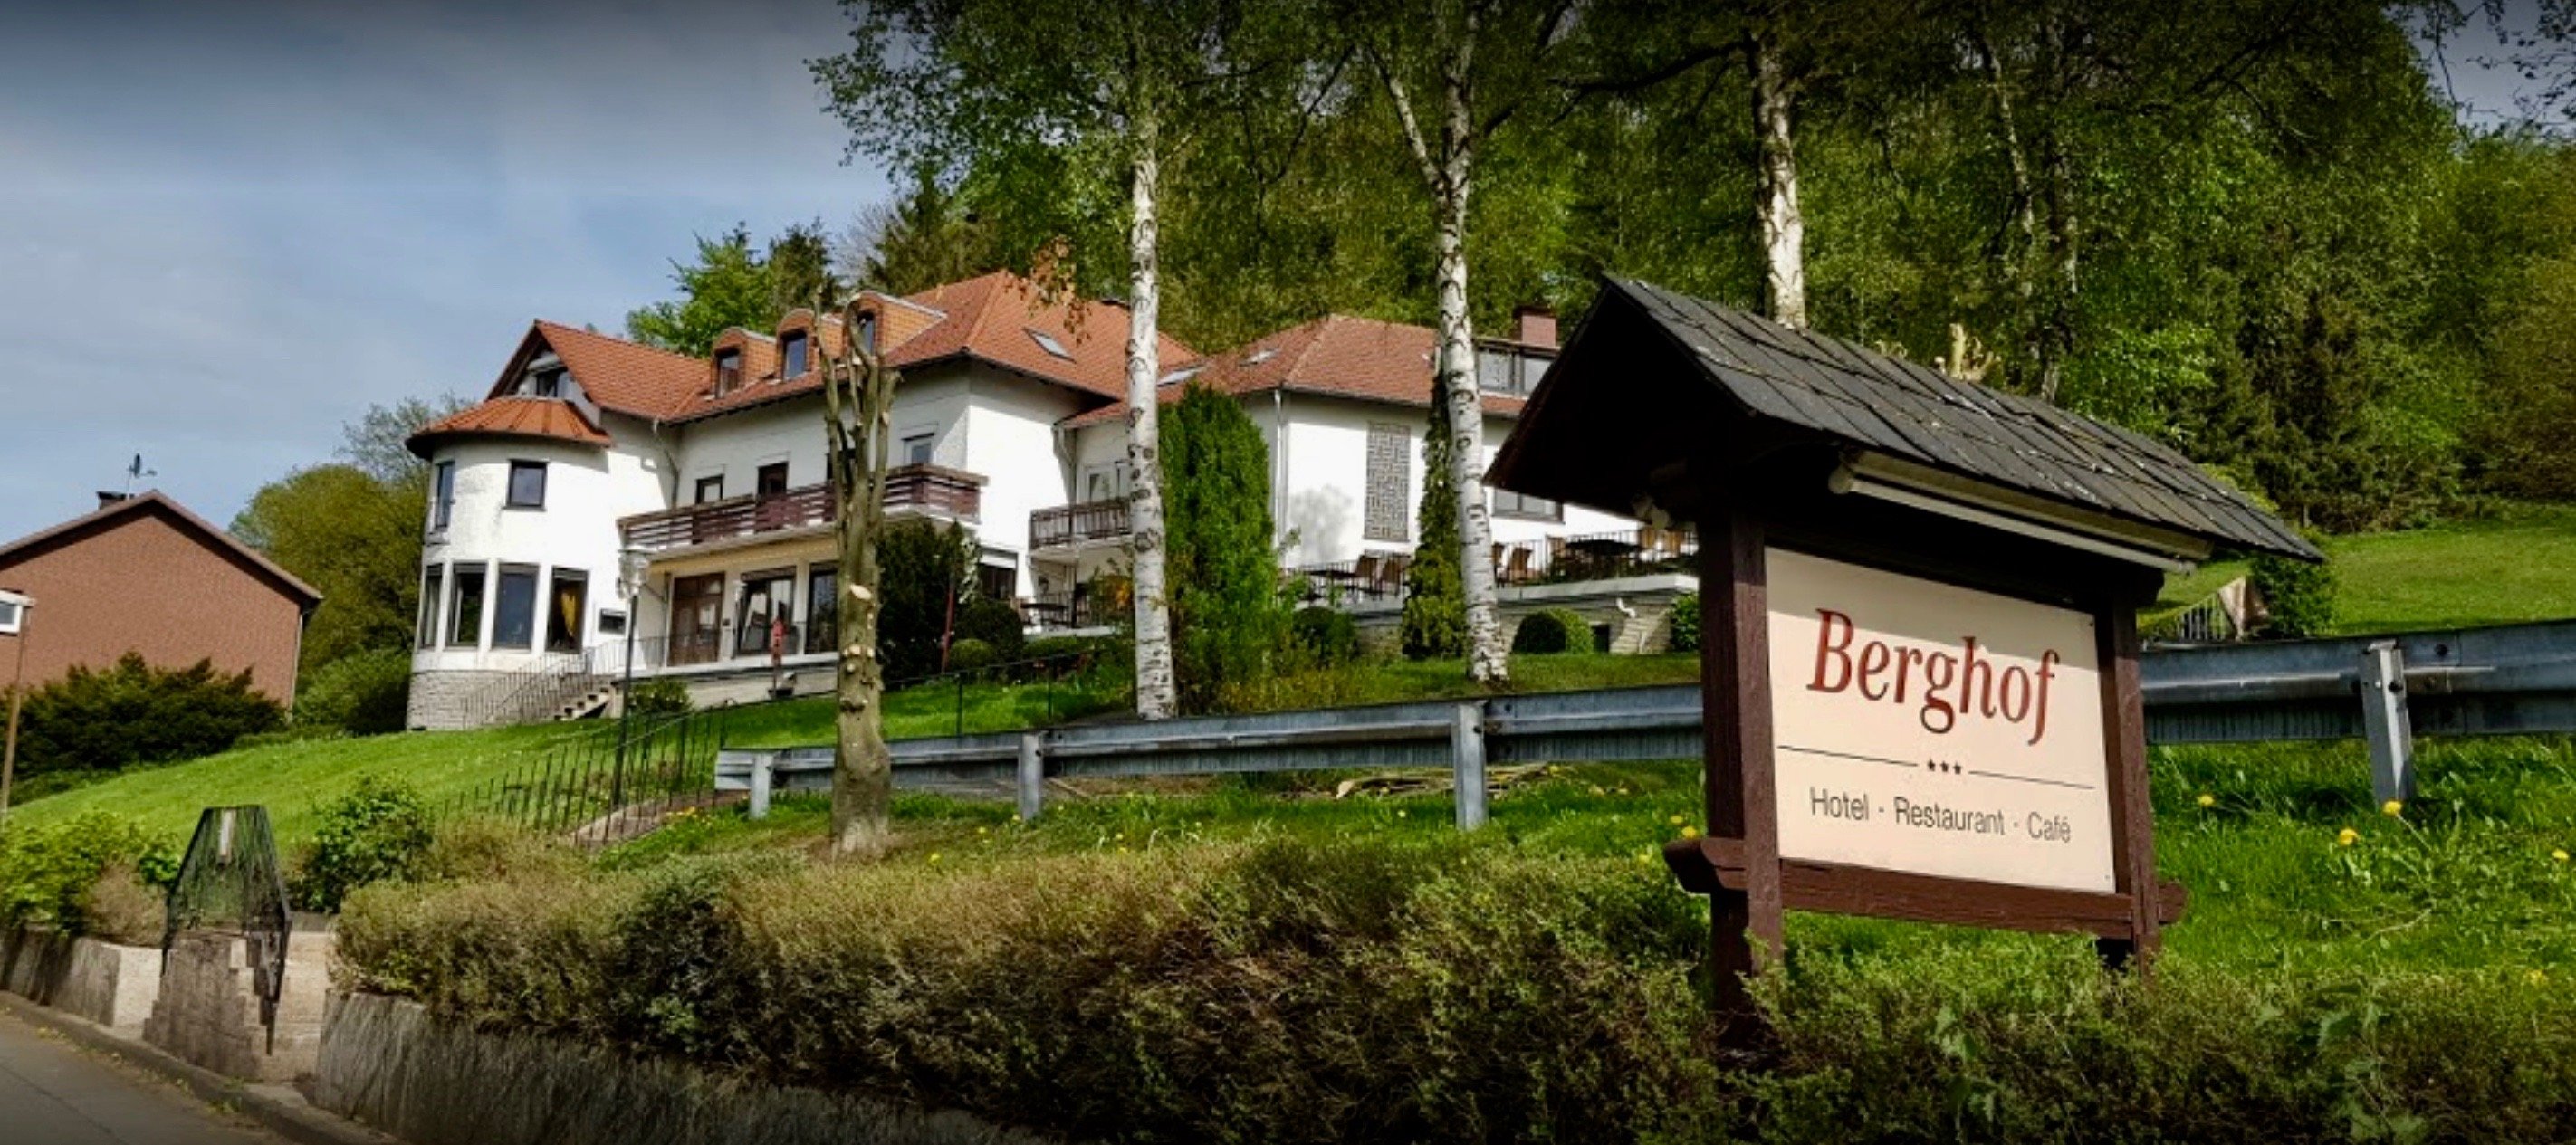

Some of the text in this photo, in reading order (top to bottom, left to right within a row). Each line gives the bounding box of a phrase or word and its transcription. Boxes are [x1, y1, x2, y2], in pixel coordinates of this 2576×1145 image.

[1805, 607, 2061, 746] Berghof
[1809, 786, 2072, 844] Hotel Restaurant Café
